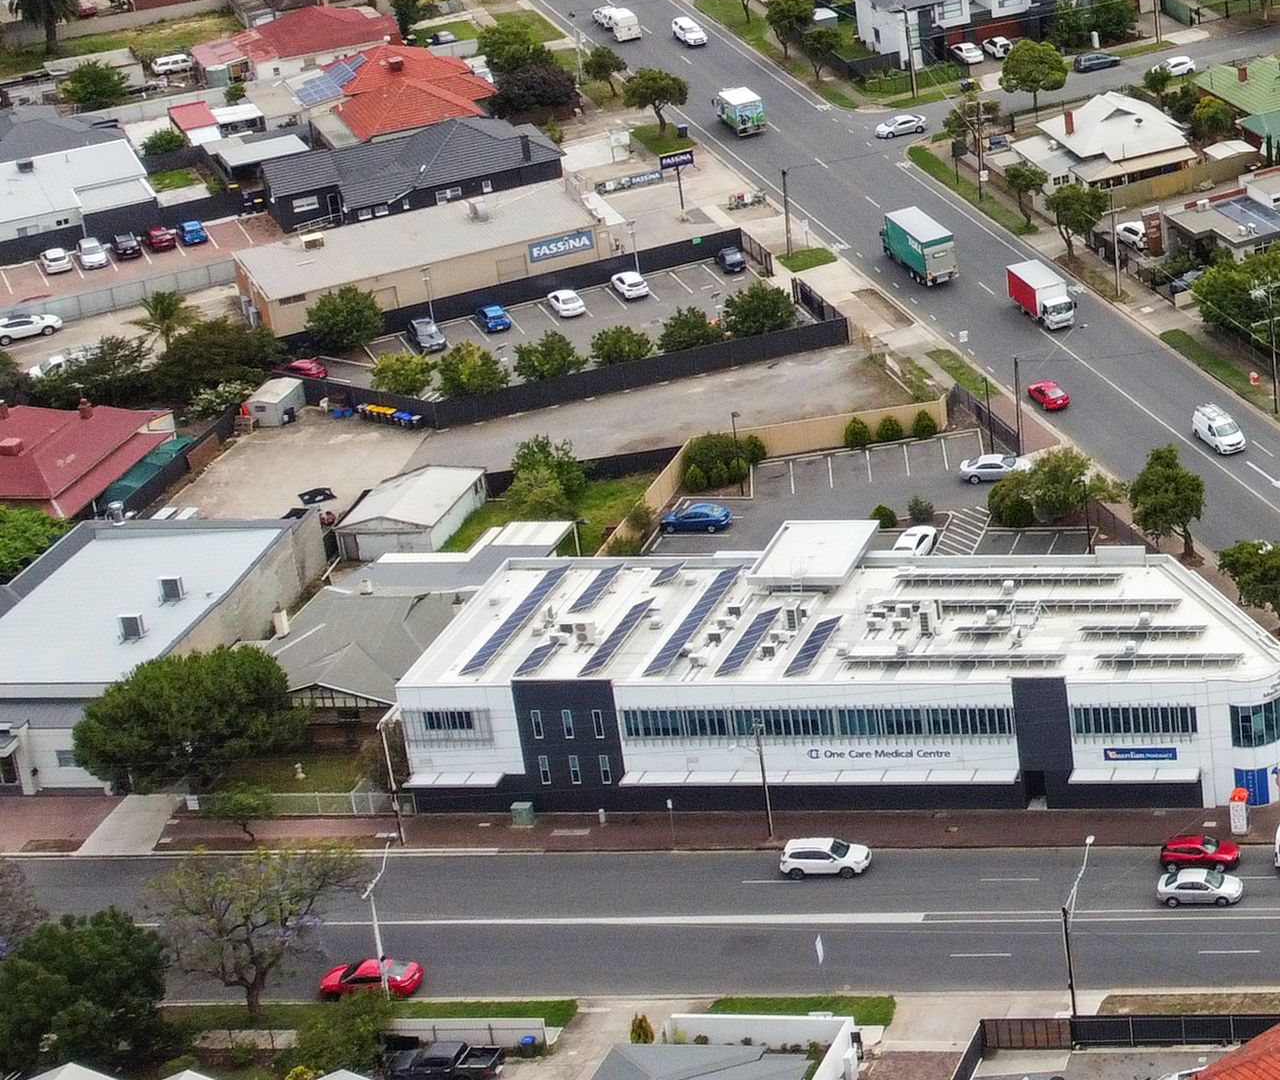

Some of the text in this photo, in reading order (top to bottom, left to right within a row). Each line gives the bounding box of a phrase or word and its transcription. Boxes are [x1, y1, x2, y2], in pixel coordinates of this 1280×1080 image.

[824, 749, 951, 758] One Care Medical Centre
